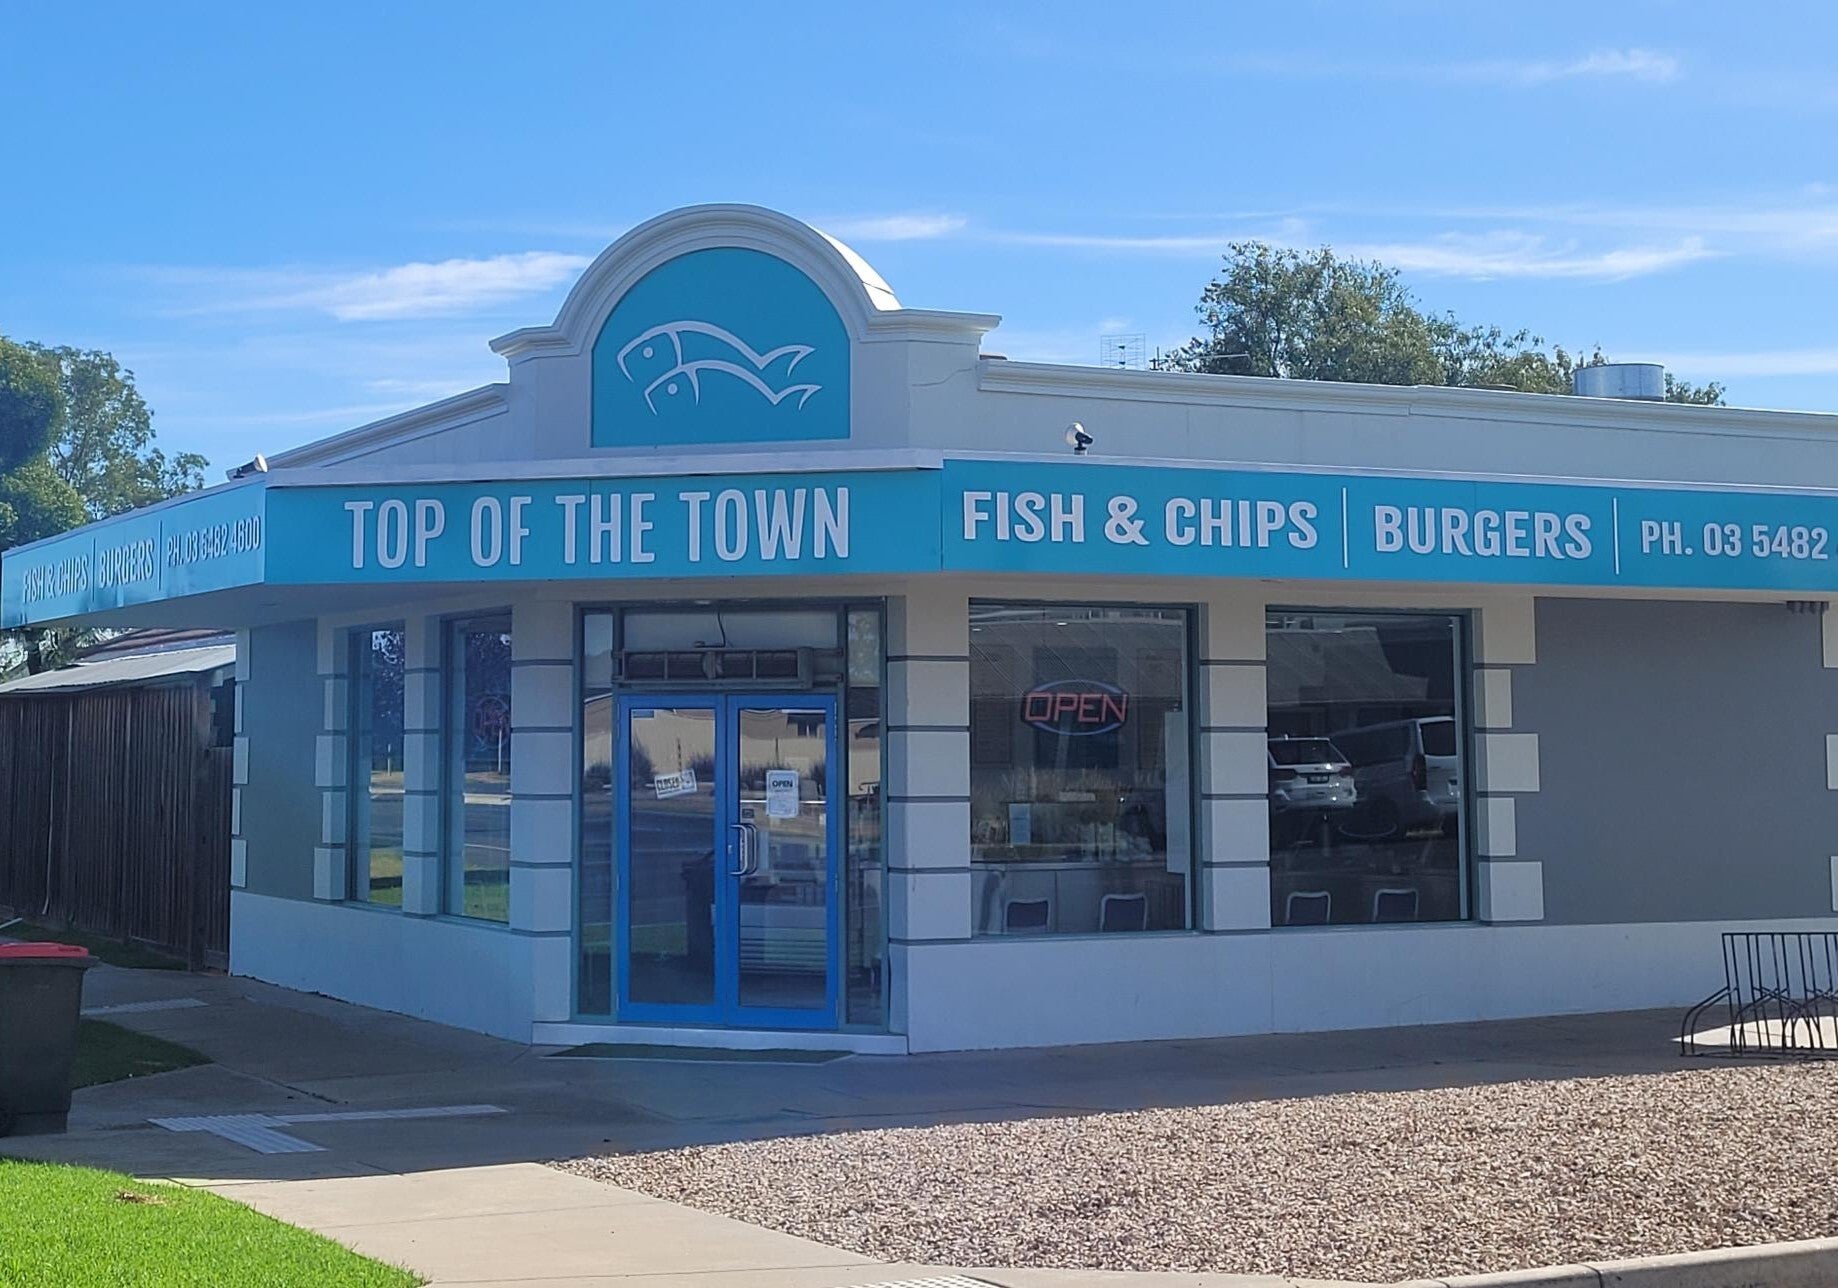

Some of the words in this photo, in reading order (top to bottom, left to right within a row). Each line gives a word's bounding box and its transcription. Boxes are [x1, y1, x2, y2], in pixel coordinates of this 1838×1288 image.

[344, 499, 445, 568] TOP
[471, 496, 532, 567] OF
[555, 493, 655, 564] THE
[679, 487, 849, 562] TOWN
[963, 491, 1085, 543] FISH
[1104, 495, 1149, 545] &
[1165, 497, 1318, 549] CHIPS
[1374, 505, 1592, 559] BURGERS
[1641, 520, 1693, 555] PH.
[1703, 523, 1742, 557] 03
[1752, 525, 1828, 559] 5482
[24, 565, 45, 603] FISH
[47, 563, 56, 599] &
[58, 554, 89, 596] CHIPS
[100, 538, 155, 589] BURGERS
[167, 533, 184, 567] PH.
[186, 529, 199, 563] 03
[201, 523, 228, 560] 5482
[1024, 692, 1128, 723] OPEN
[772, 780, 793, 788] OPEN
